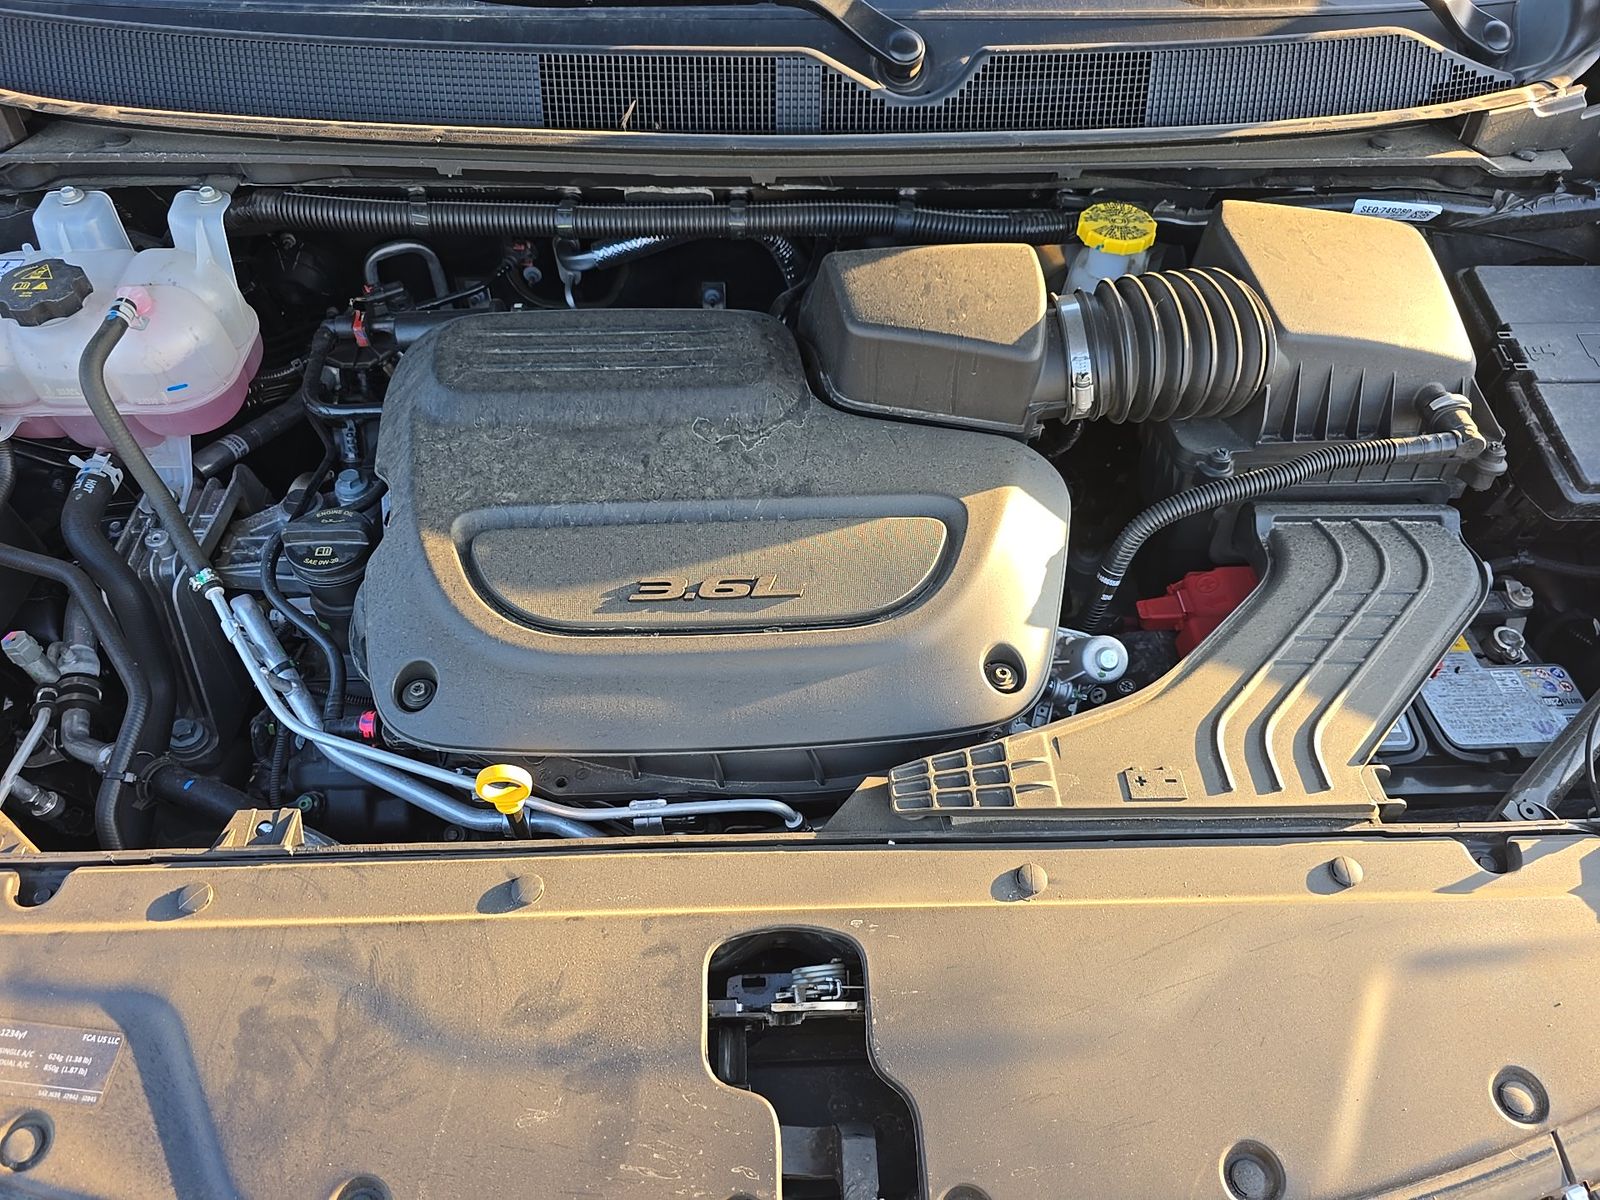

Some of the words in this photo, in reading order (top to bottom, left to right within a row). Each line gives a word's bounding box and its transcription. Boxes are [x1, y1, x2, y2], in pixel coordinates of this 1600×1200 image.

[316, 509, 342, 517] ENGINE
[303, 558, 318, 566] SAE
[628, 574, 804, 602] 3.6L
[82, 1033, 96, 1043] FCA
[97, 1035, 107, 1043] US
[107, 1036, 120, 1045] LLC
